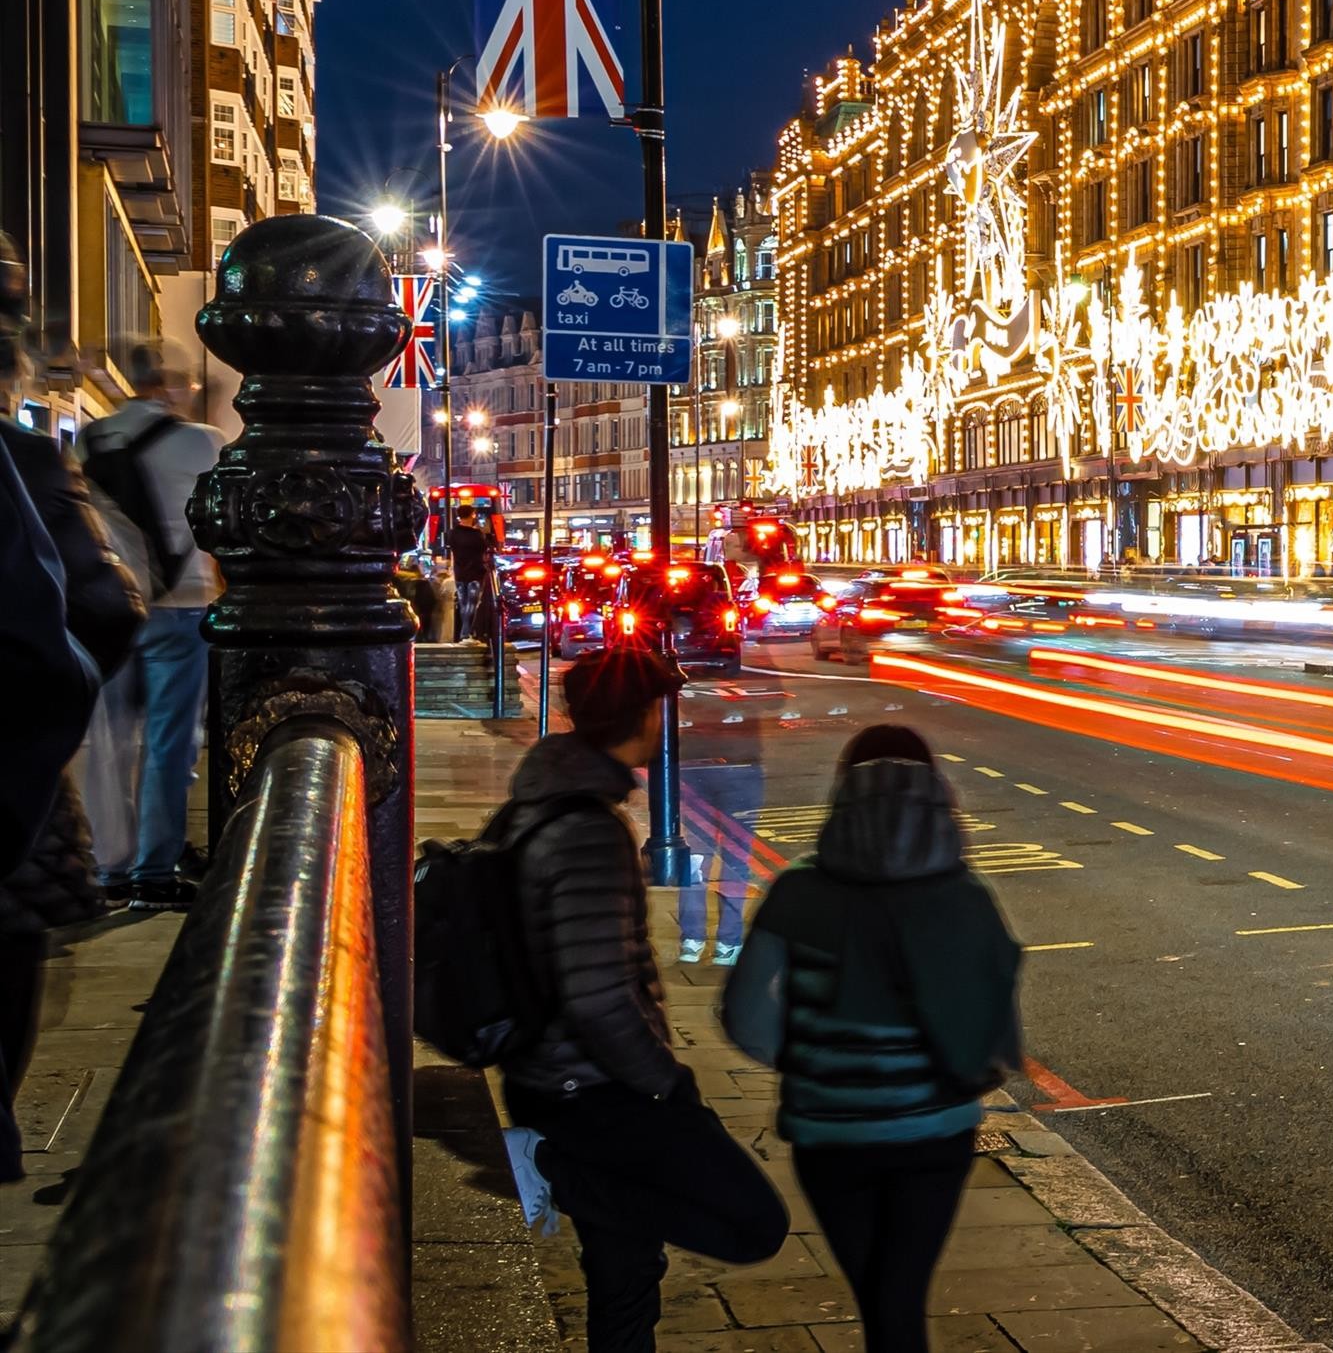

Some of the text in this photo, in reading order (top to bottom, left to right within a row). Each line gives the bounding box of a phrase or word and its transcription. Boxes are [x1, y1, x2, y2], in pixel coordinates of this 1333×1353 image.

[557, 311, 589, 325] taxi
[578, 337, 675, 354] At all times
